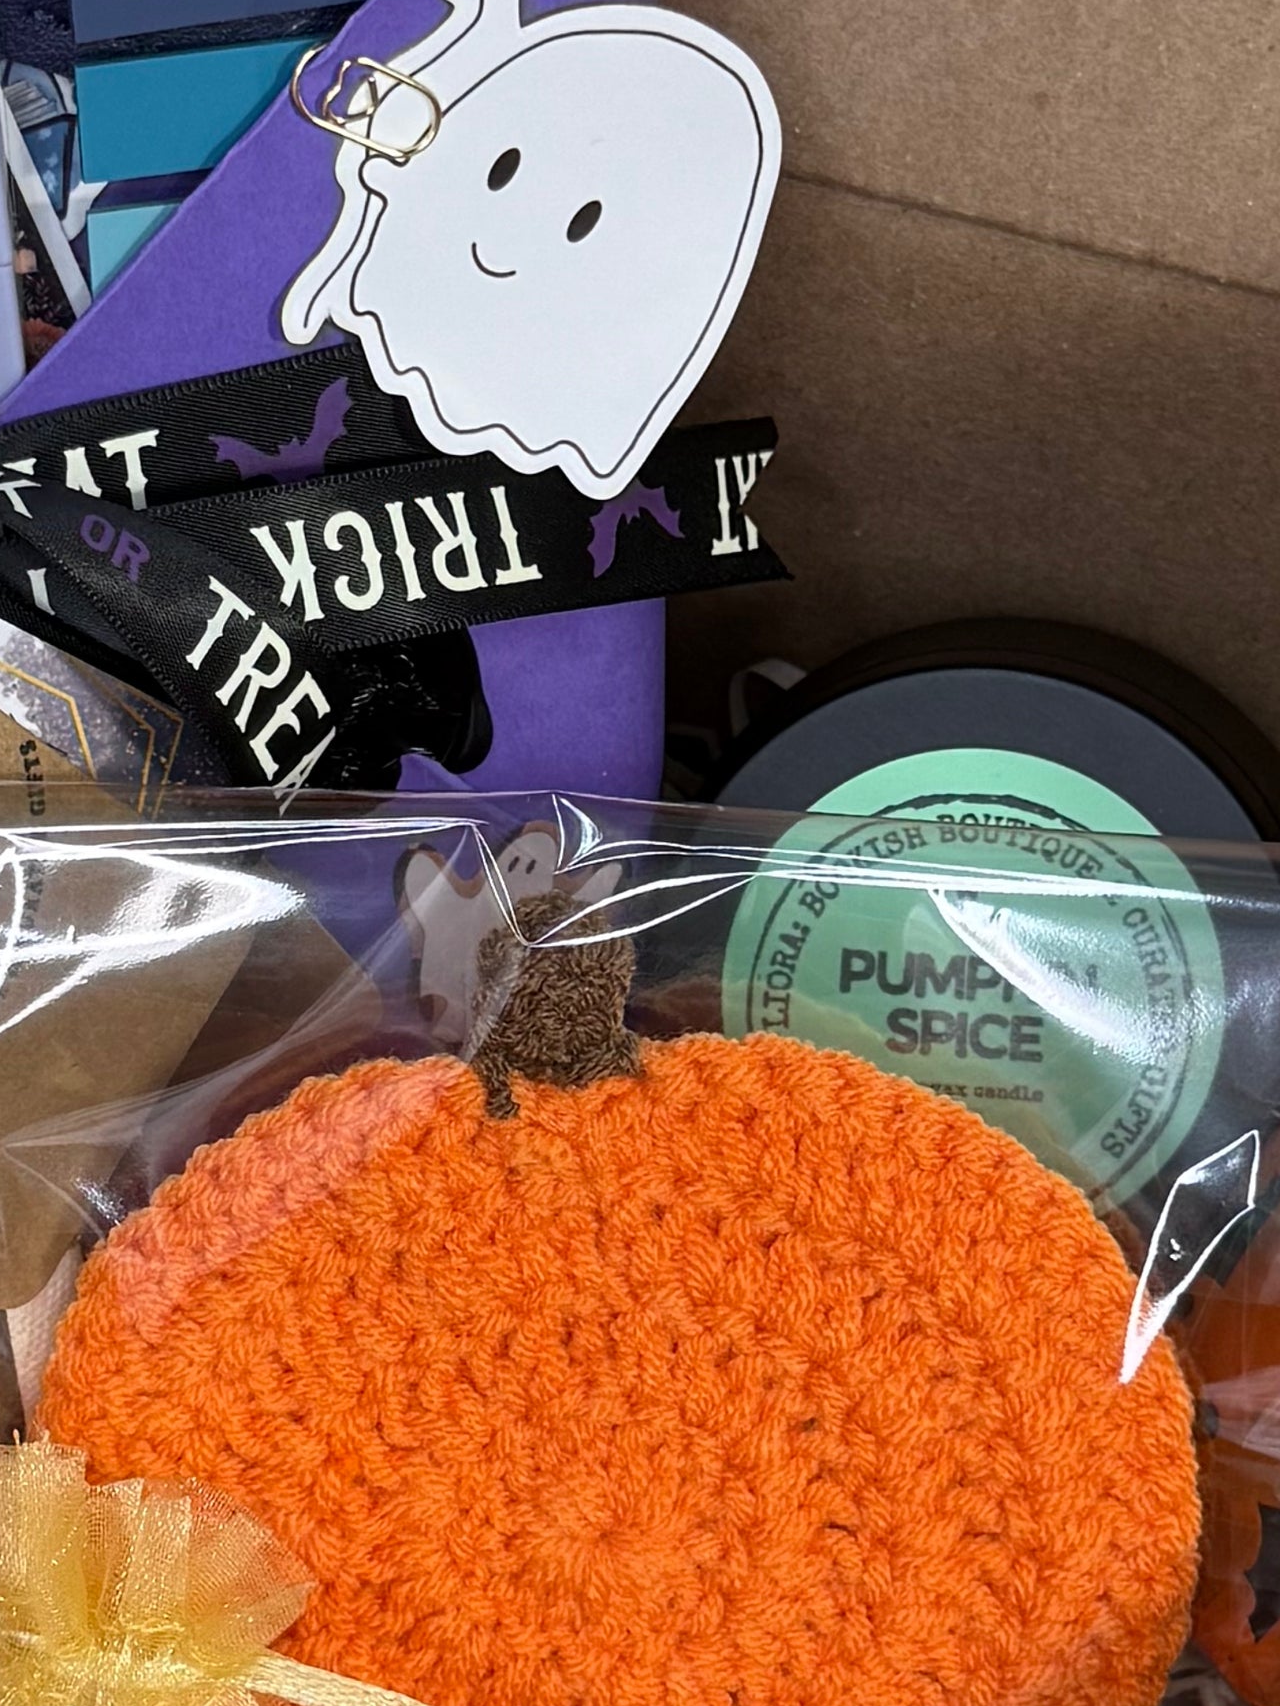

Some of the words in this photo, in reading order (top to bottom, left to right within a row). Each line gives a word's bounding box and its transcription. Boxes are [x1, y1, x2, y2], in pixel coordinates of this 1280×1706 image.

[250, 485, 543, 624] TRICK
[79, 513, 151, 584] OR
[185, 575, 337, 817] TREA
[885, 1006, 1045, 1064] SPICE
[973, 1084, 1045, 1104] candle
